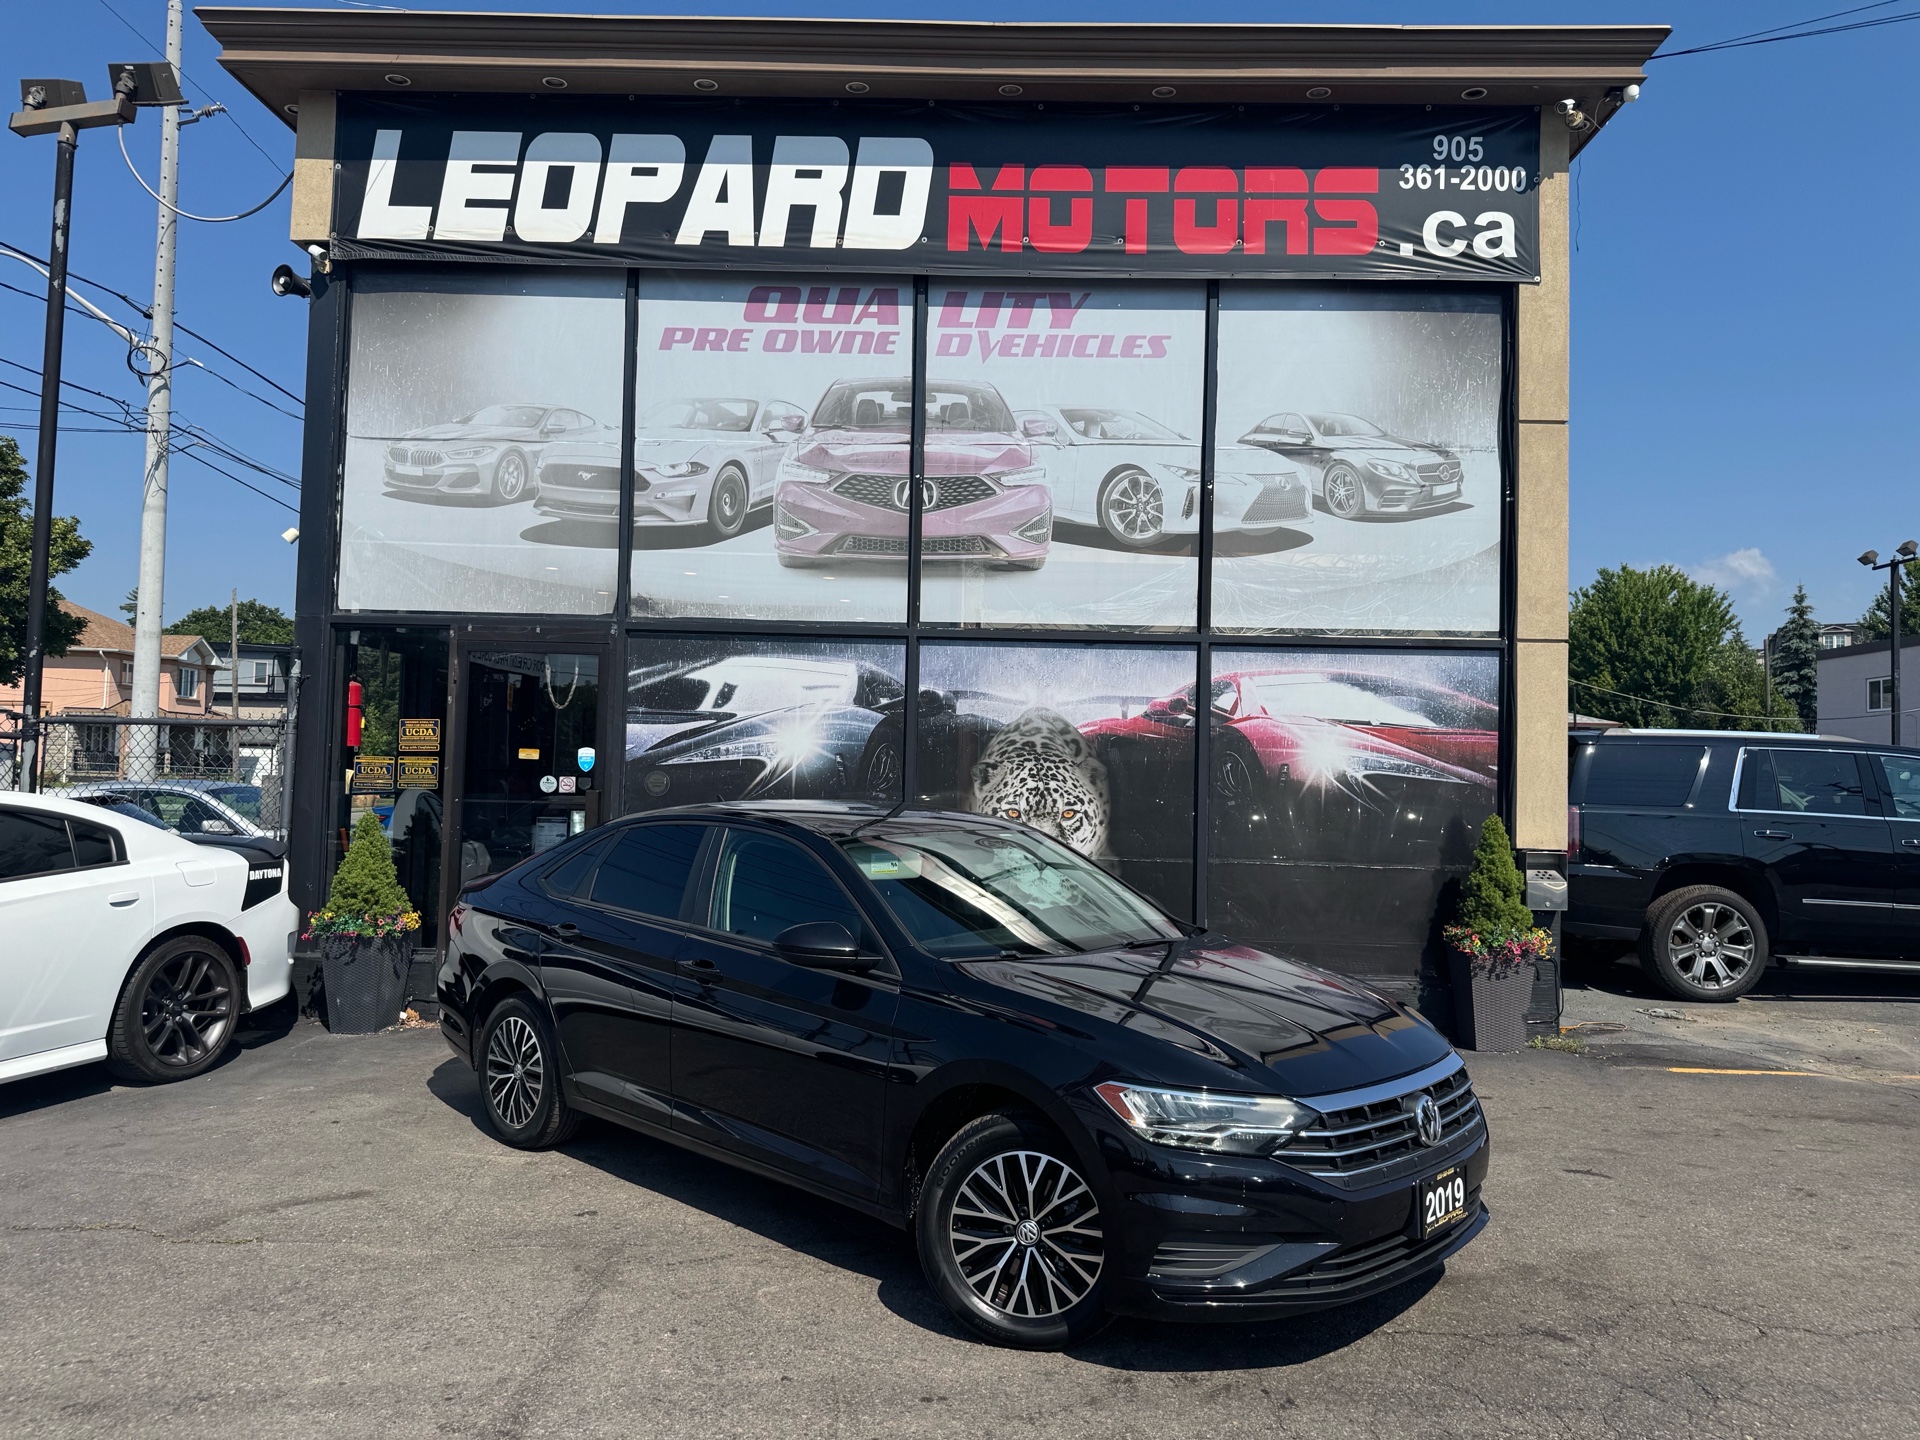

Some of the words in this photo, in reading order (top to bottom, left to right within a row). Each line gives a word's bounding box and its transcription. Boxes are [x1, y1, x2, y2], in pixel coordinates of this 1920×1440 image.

[1433, 135, 1484, 162] 905
[1399, 164, 1527, 192] 361-2000
[357, 129, 934, 250] LEOPARD
[947, 162, 1379, 256] MOTORS
[1400, 210, 1518, 258] .ca
[658, 327, 753, 352] PRE
[405, 728, 434, 736] UCDA
[361, 766, 388, 774] UCDA
[405, 767, 432, 775] UCDA
[249, 867, 282, 880] DAYTONA
[1425, 1177, 1464, 1224] 2019
[1434, 1206, 1464, 1228] LEOPARD
